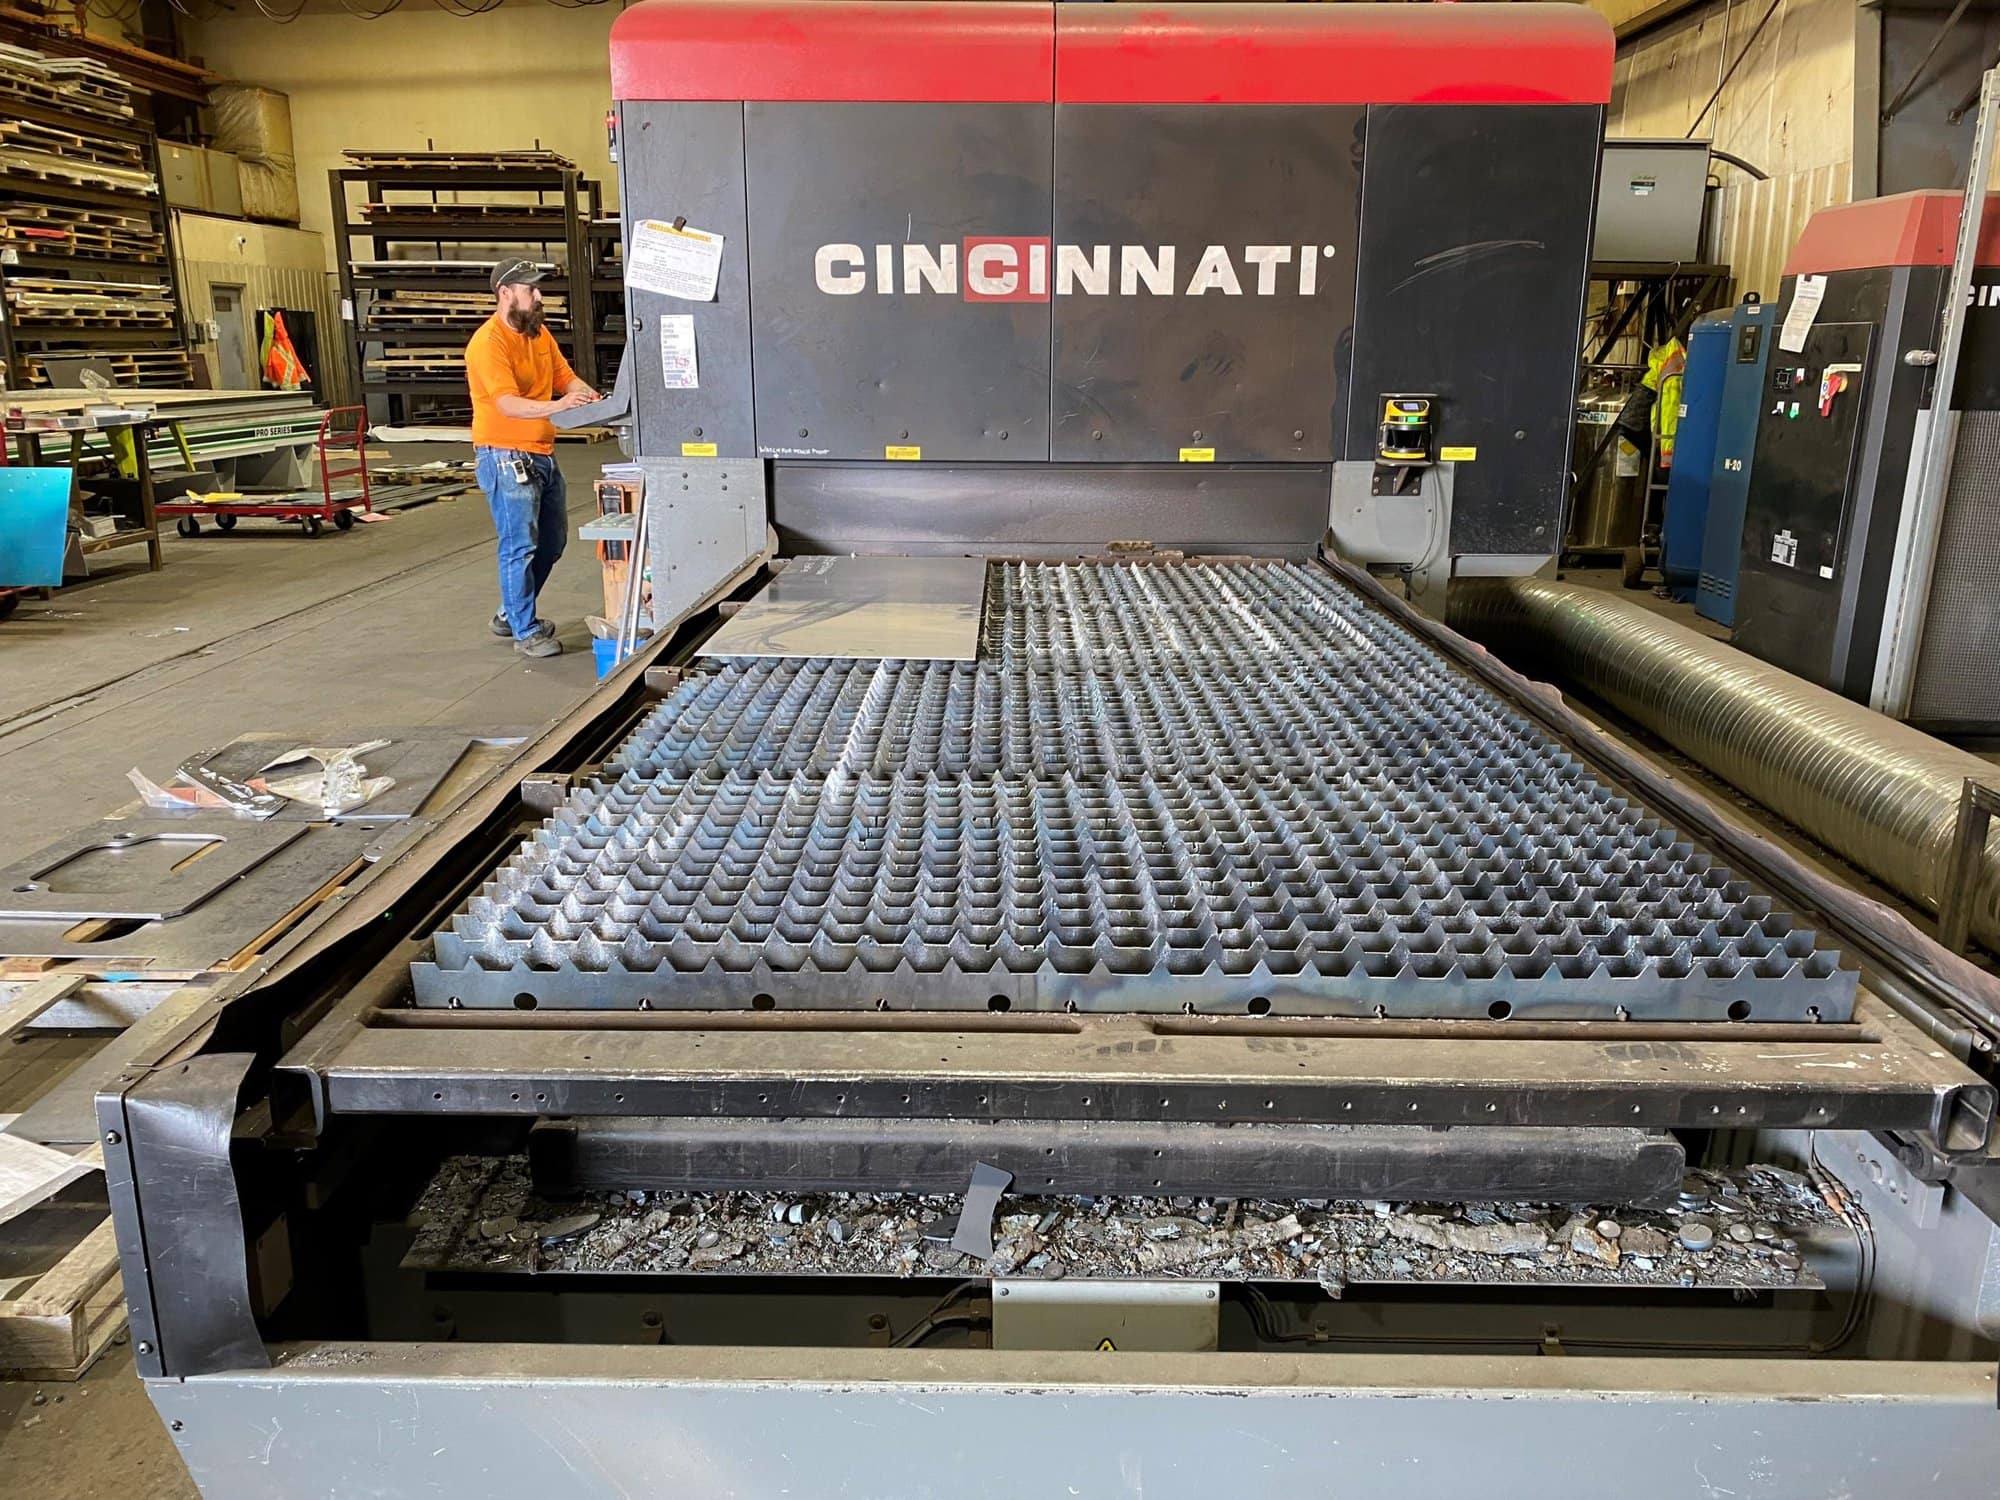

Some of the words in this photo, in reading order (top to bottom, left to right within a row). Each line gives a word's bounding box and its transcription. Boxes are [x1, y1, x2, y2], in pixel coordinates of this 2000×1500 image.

[814, 244, 1318, 296] CINCINNATI
[256, 428, 269, 437] PRO
[270, 426, 291, 436] SERIES
